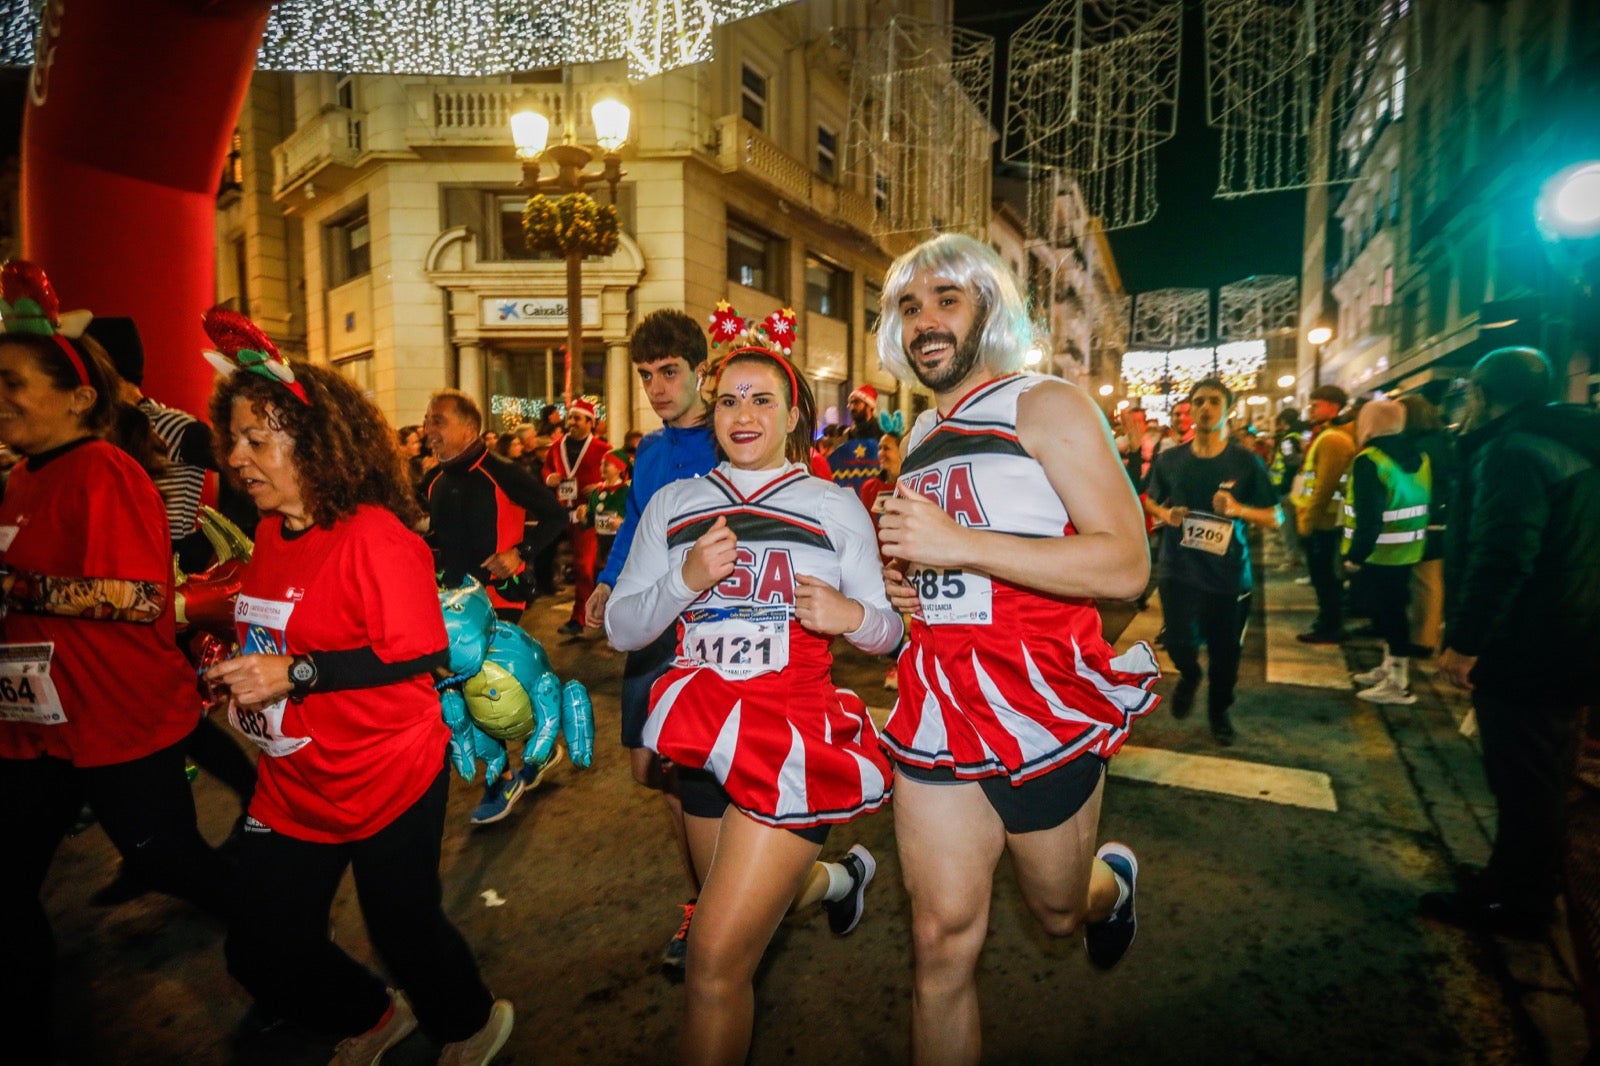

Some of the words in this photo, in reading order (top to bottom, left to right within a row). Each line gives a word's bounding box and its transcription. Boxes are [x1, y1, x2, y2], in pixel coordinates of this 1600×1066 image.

[522, 303, 568, 316] CaixaBa
[1187, 526, 1224, 544] 1209
[681, 546, 796, 605] SA
[237, 601, 249, 616] 30
[696, 636, 771, 665] 1121
[0, 677, 36, 704] 64
[236, 706, 274, 741] 882
